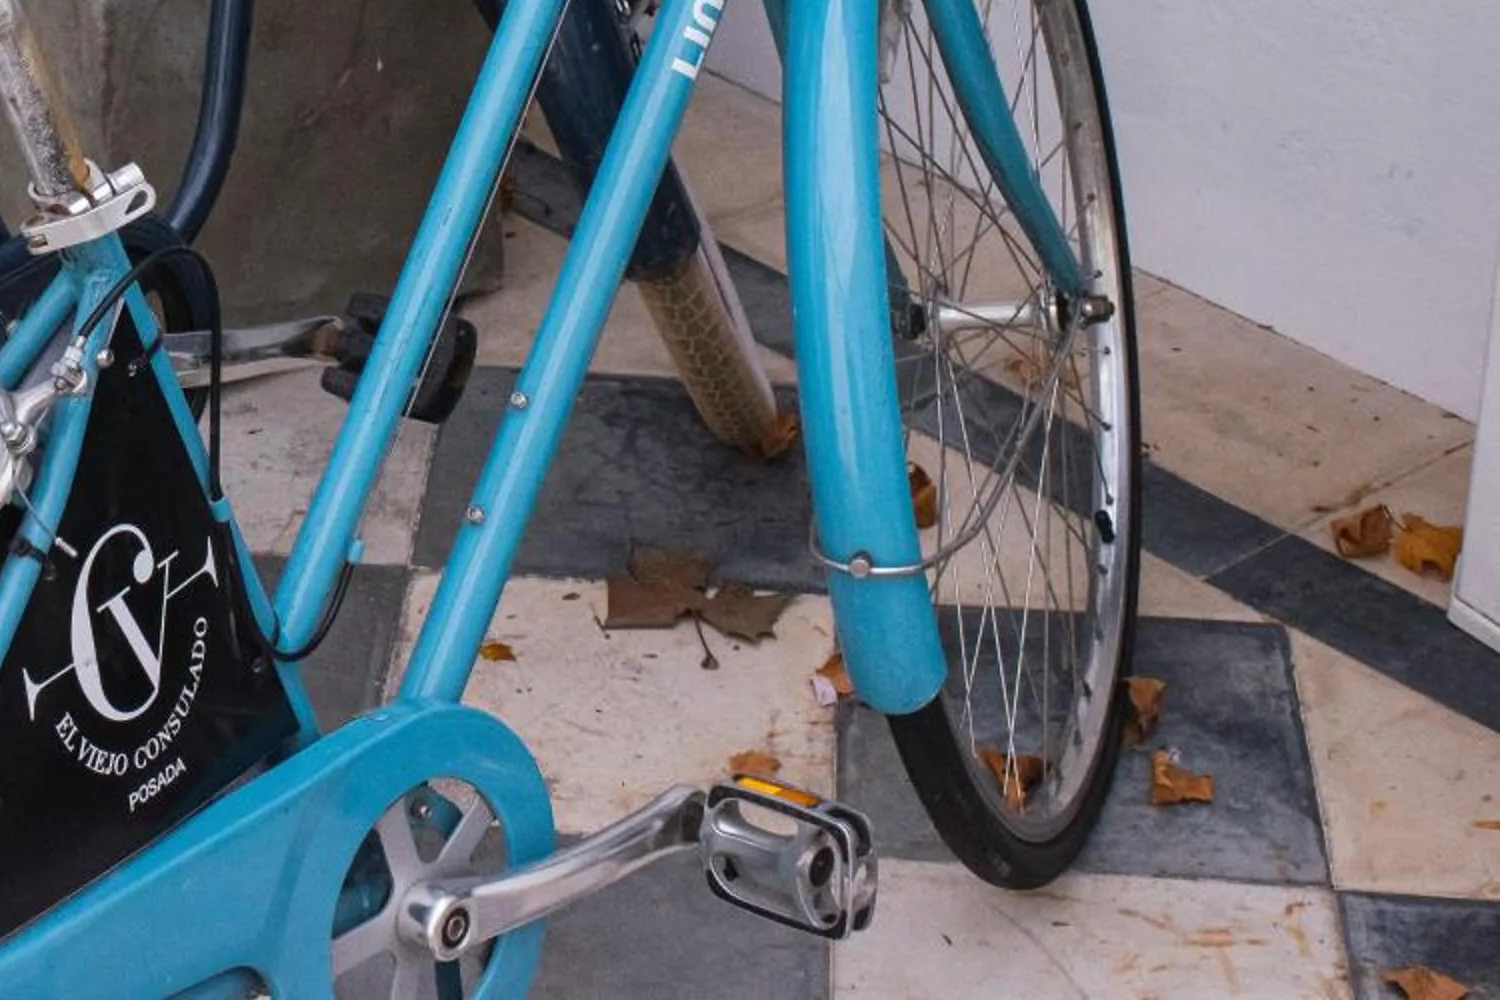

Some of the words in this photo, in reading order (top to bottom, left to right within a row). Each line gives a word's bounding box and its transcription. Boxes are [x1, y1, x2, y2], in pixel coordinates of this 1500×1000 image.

[54, 711, 77, 753] EL
[75, 735, 129, 777] VIEJO
[133, 616, 209, 770] CONSULADO
[127, 756, 188, 813] POSADA
